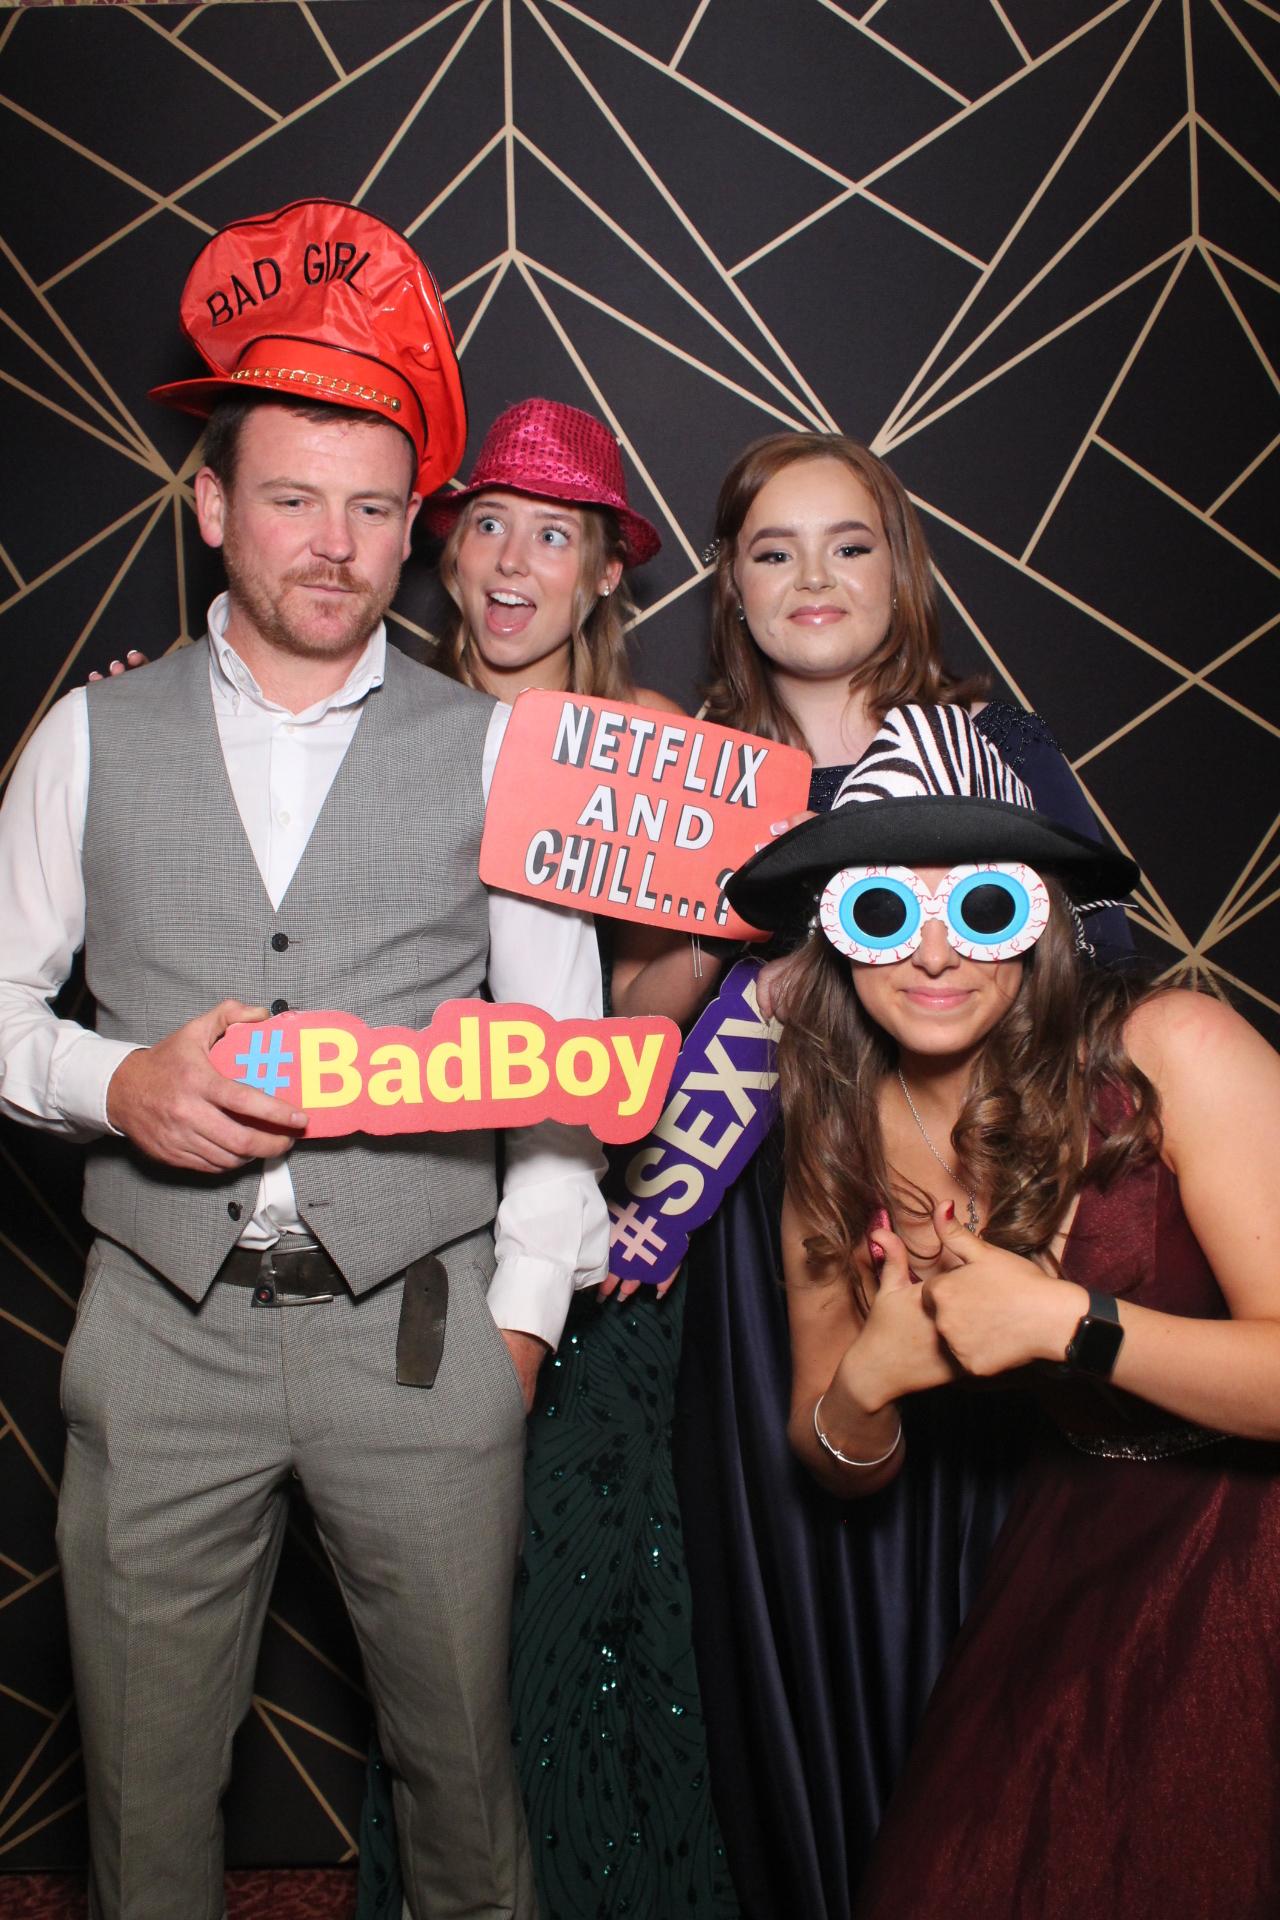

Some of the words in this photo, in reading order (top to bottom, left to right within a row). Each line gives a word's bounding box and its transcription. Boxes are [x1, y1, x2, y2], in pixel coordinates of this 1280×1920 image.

[205, 257, 282, 328] BAD
[303, 241, 371, 297] GIRL
[552, 701, 769, 808] NETFLIX
[576, 784, 715, 851] AND
[234, 1016, 665, 1117] #BadBoy
[606, 978, 785, 1267] #SEXY
